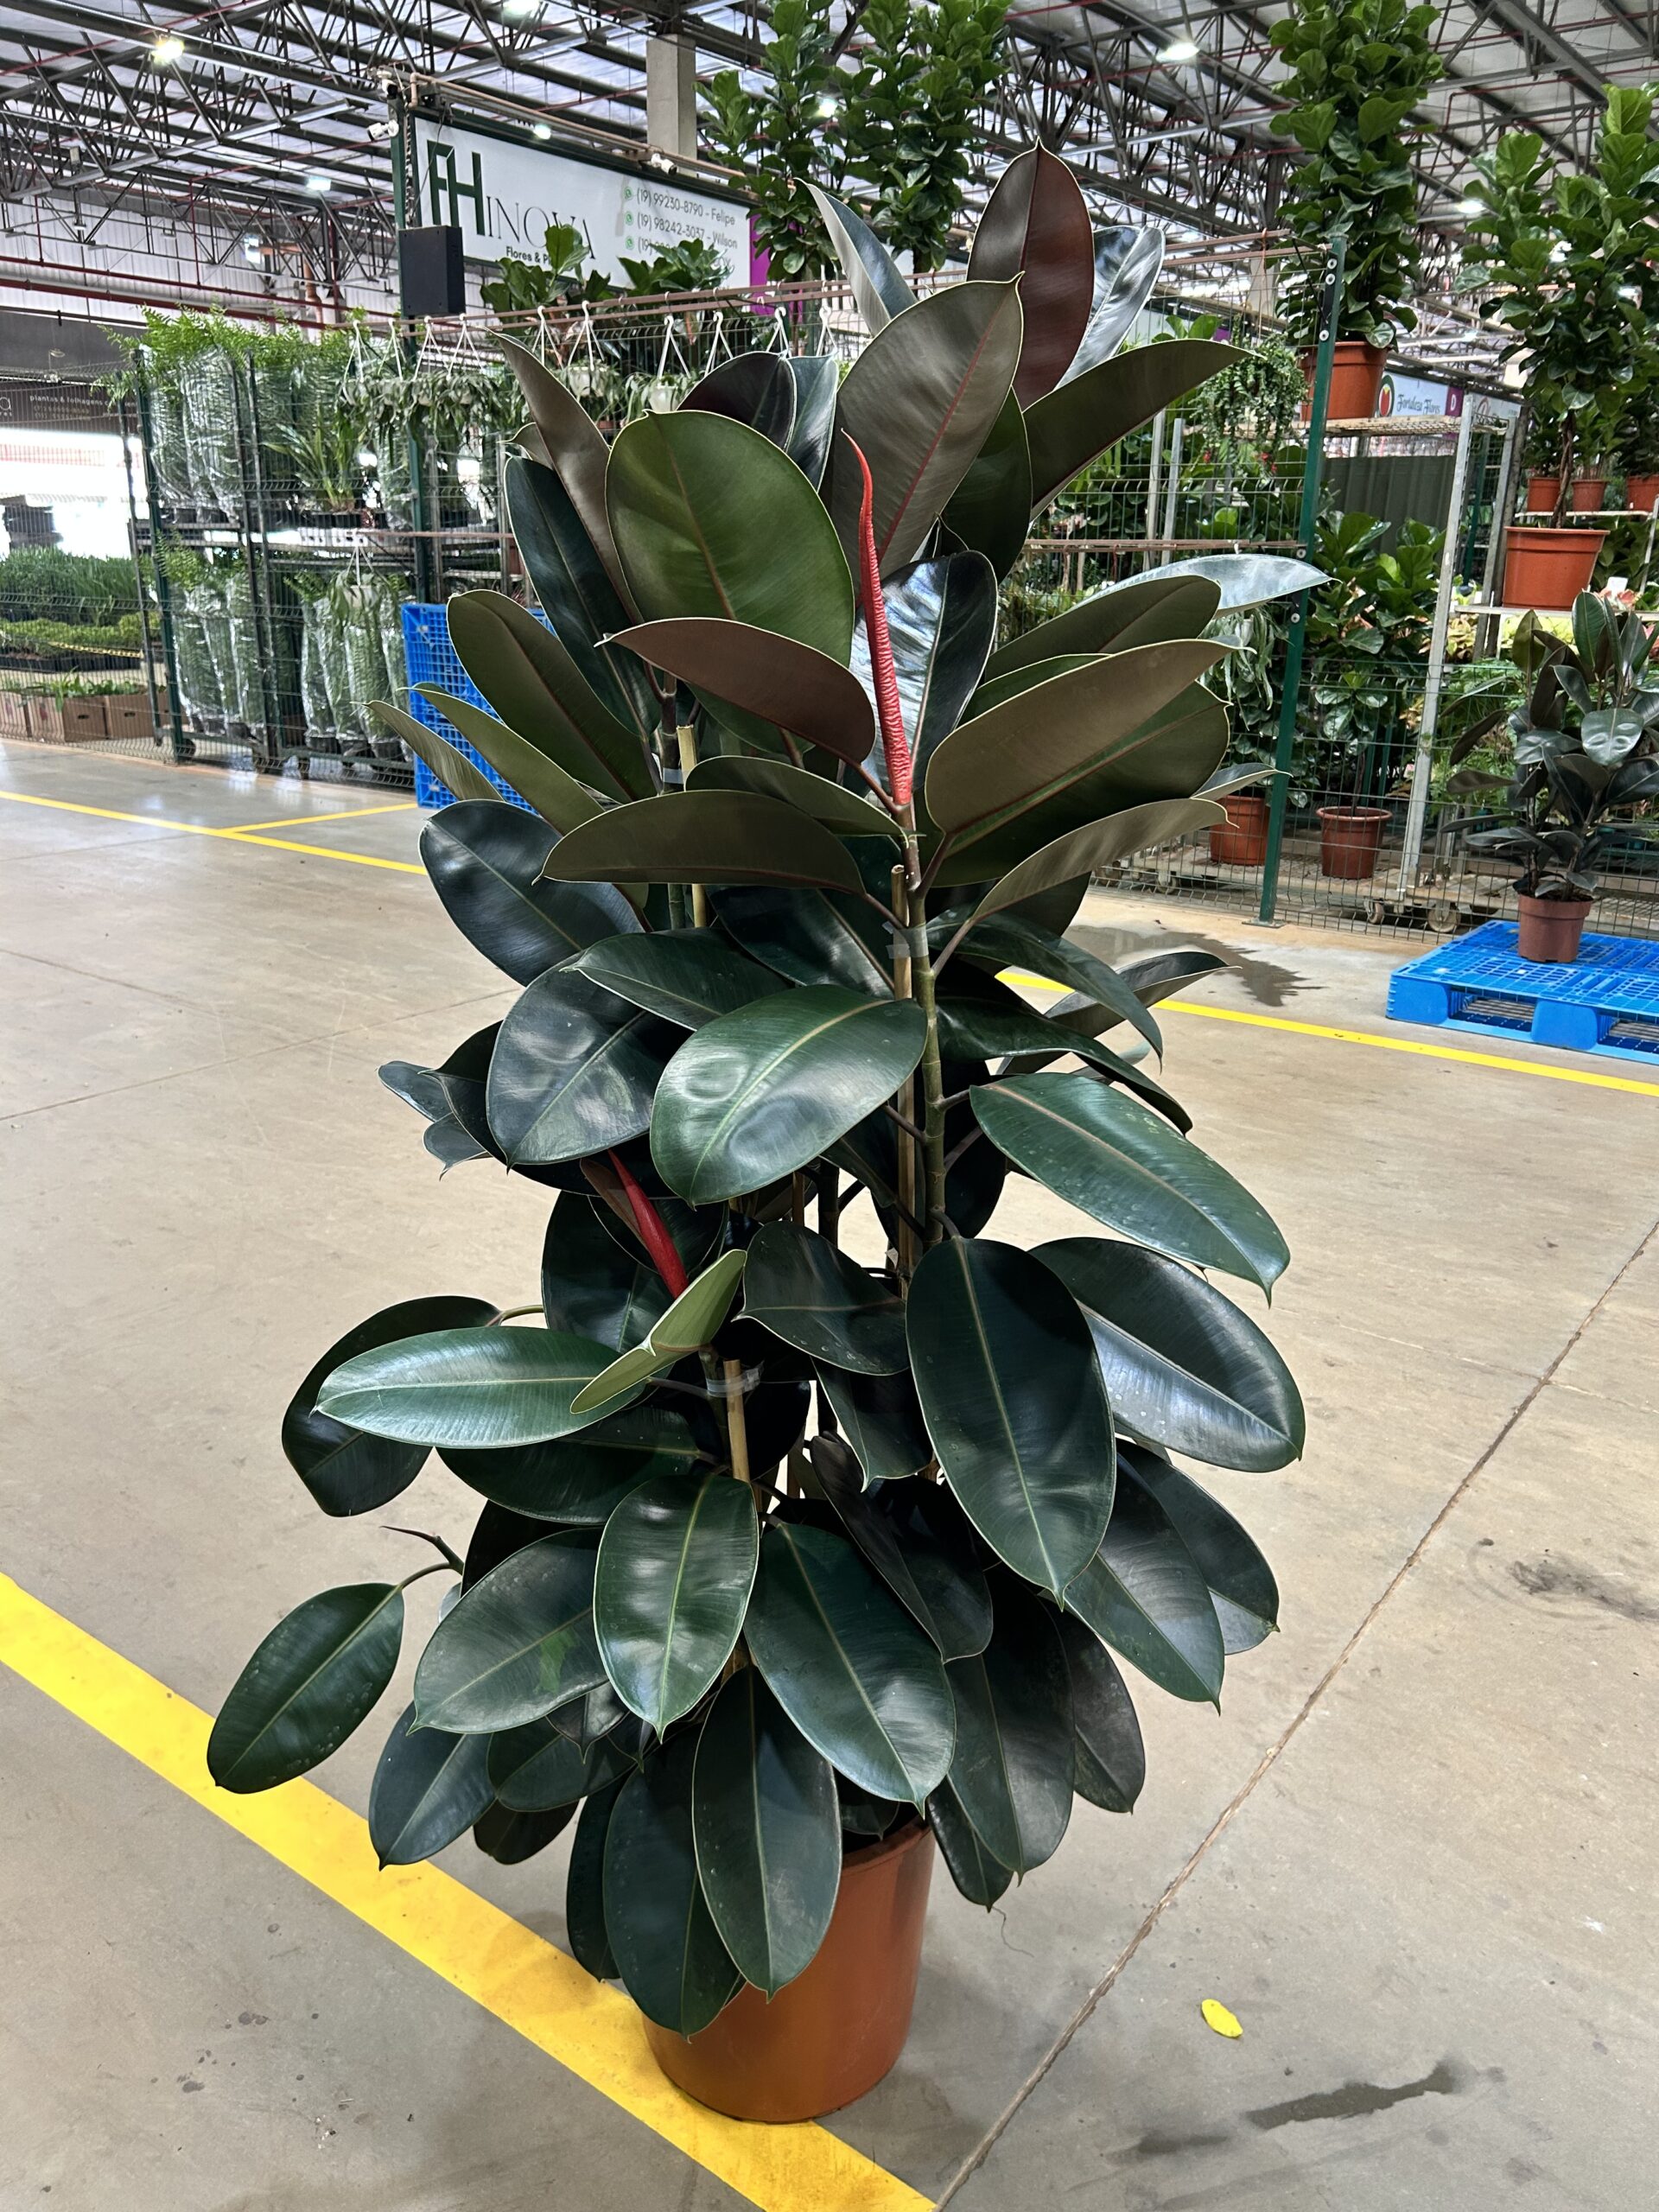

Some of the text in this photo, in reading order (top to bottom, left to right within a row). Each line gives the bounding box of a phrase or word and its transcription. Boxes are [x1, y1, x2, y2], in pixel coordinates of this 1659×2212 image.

[637, 188, 652, 207] (19)
[653, 193, 703, 217] 99230-8790
[711, 208, 735, 226] Felipe
[638, 212, 652, 232] (19)
[654, 217, 705, 239] 98242-3037
[713, 231, 738, 249] Wilson
[506, 245, 532, 262] Flores
[535, 251, 541, 263] &
